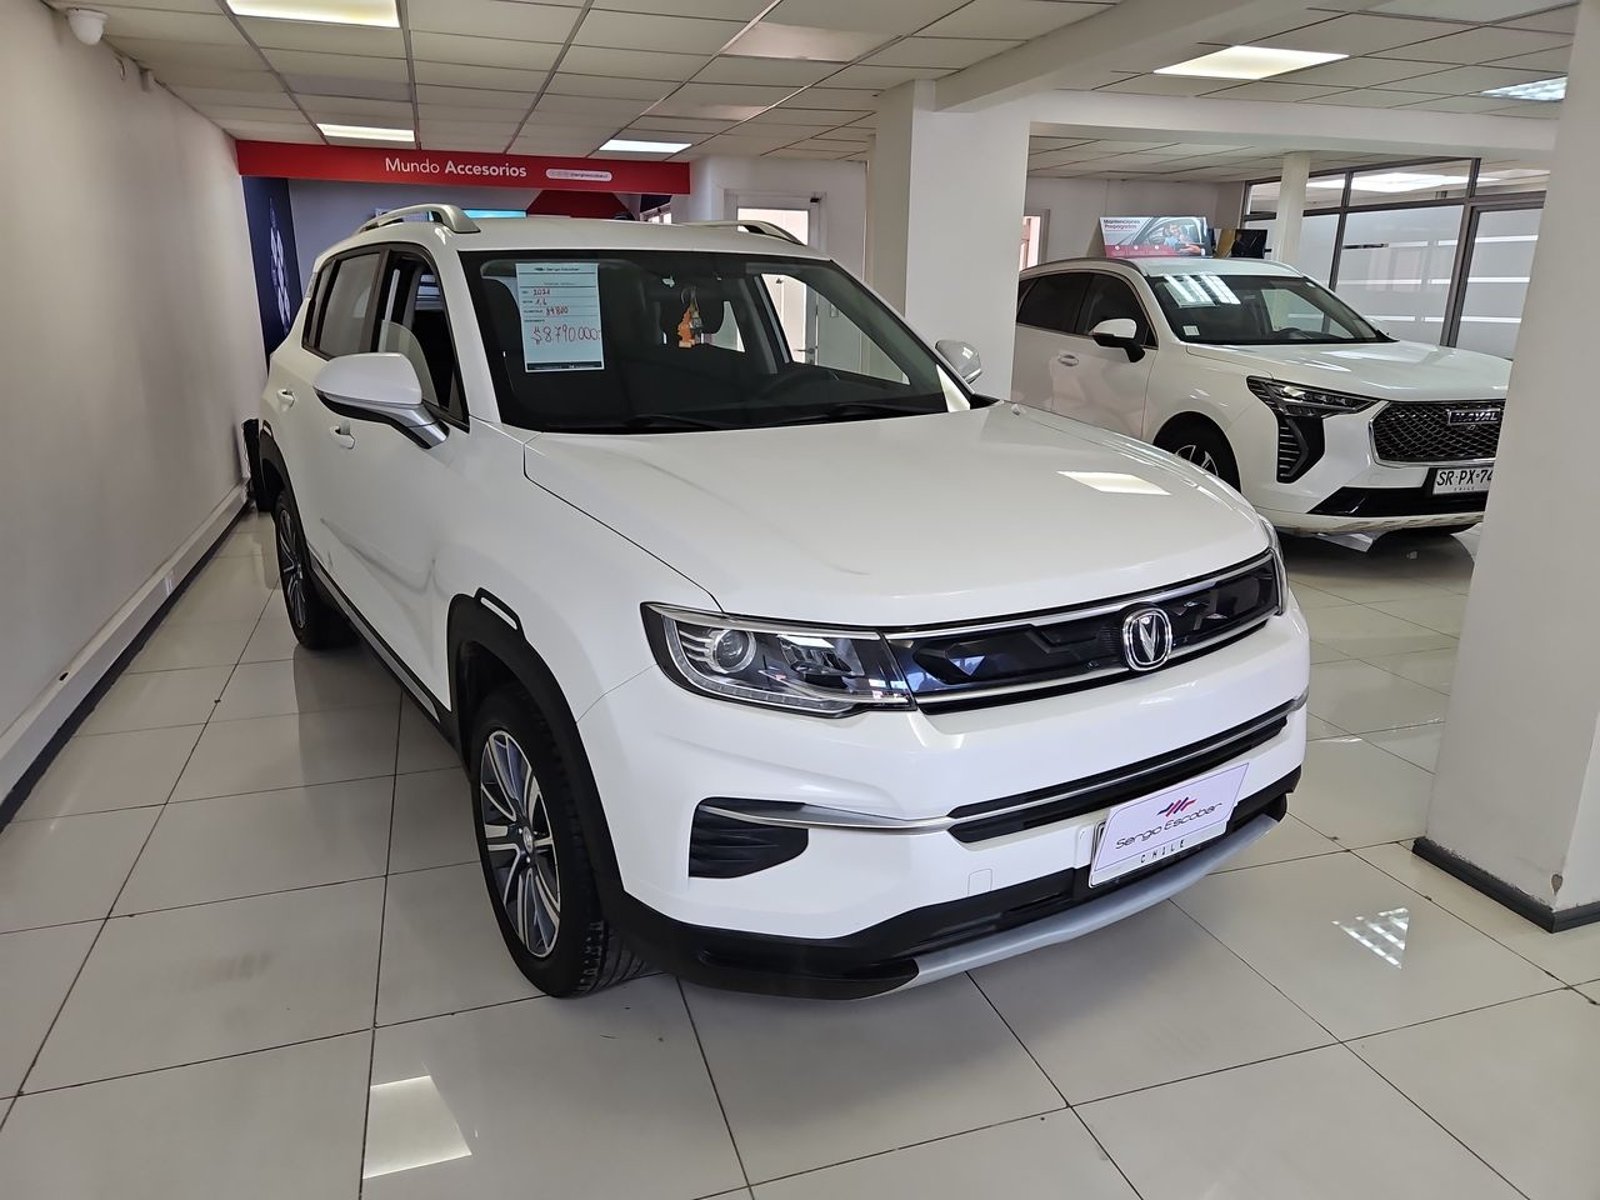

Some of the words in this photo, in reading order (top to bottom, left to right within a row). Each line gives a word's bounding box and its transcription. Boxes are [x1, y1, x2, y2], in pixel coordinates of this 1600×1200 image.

[385, 157, 440, 174] Mundo
[445, 160, 527, 177] Accesorios
[1164, 802, 1222, 830] Escobar
[1140, 839, 1185, 864] CHILE
